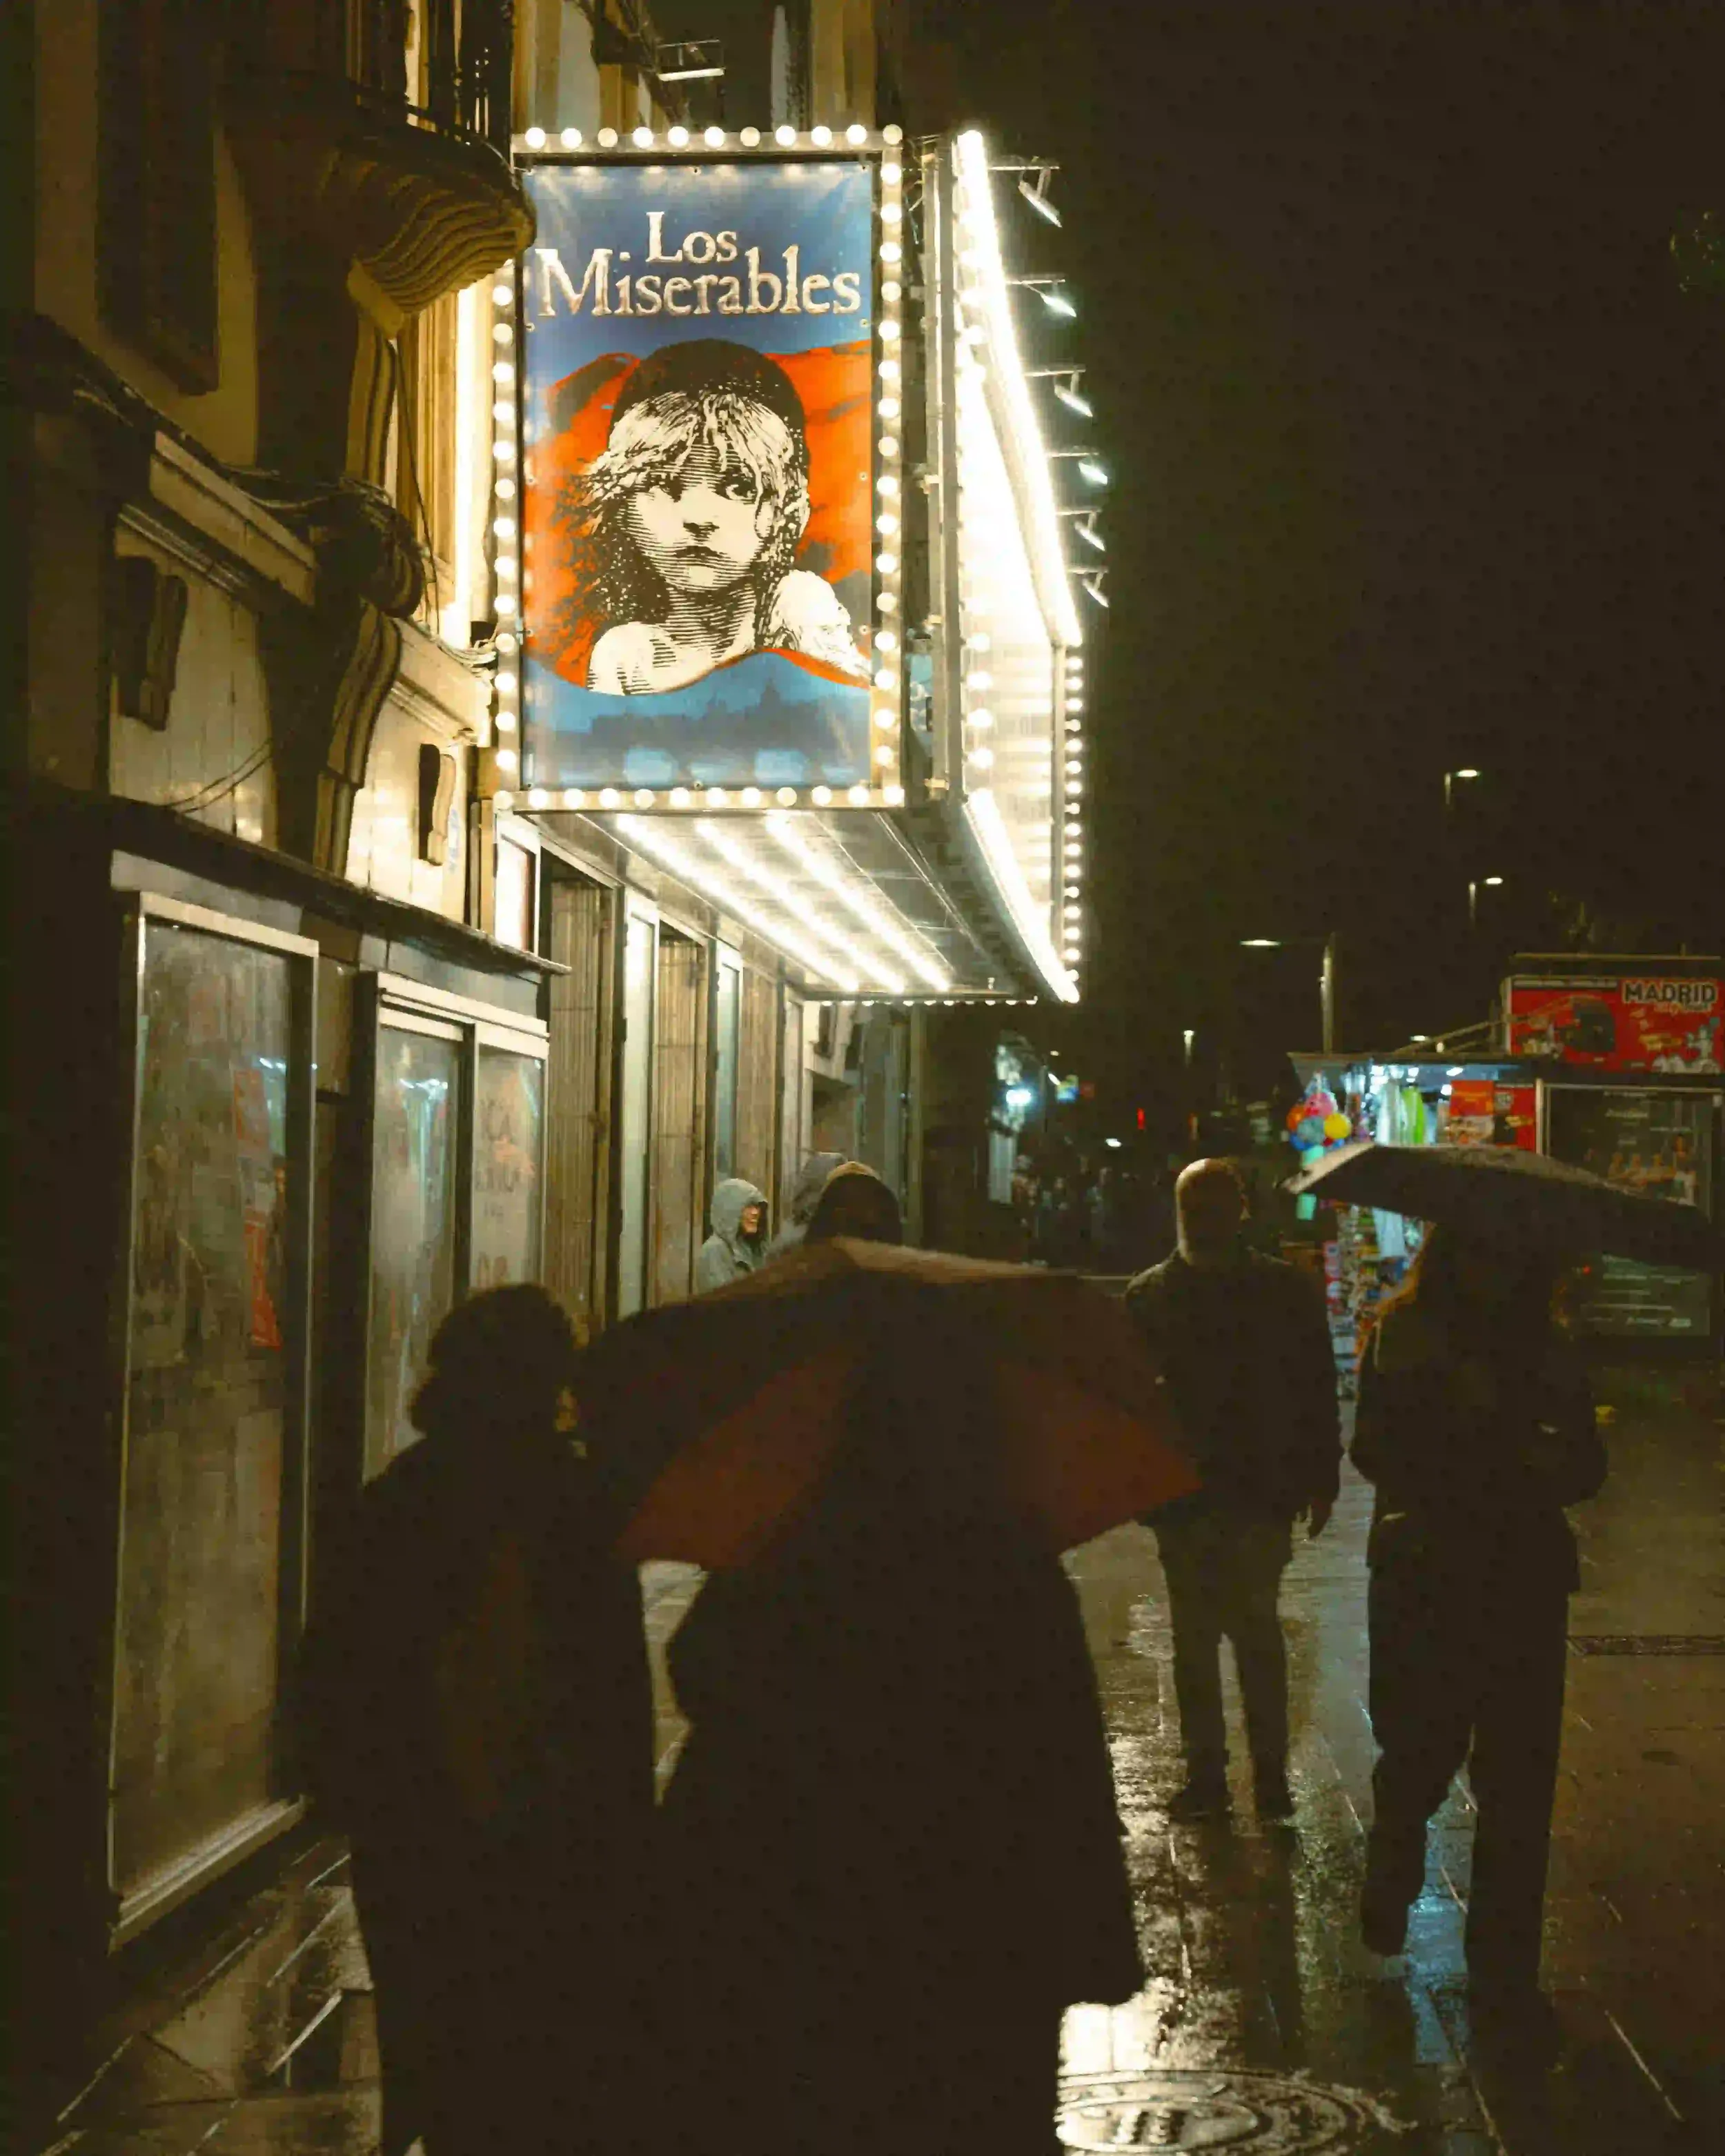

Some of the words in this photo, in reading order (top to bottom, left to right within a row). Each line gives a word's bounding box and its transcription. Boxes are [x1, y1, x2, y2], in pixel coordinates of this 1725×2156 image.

[645, 211, 738, 264] Los
[535, 244, 862, 317] Miserables
[1624, 982, 1717, 1002] MADRID
